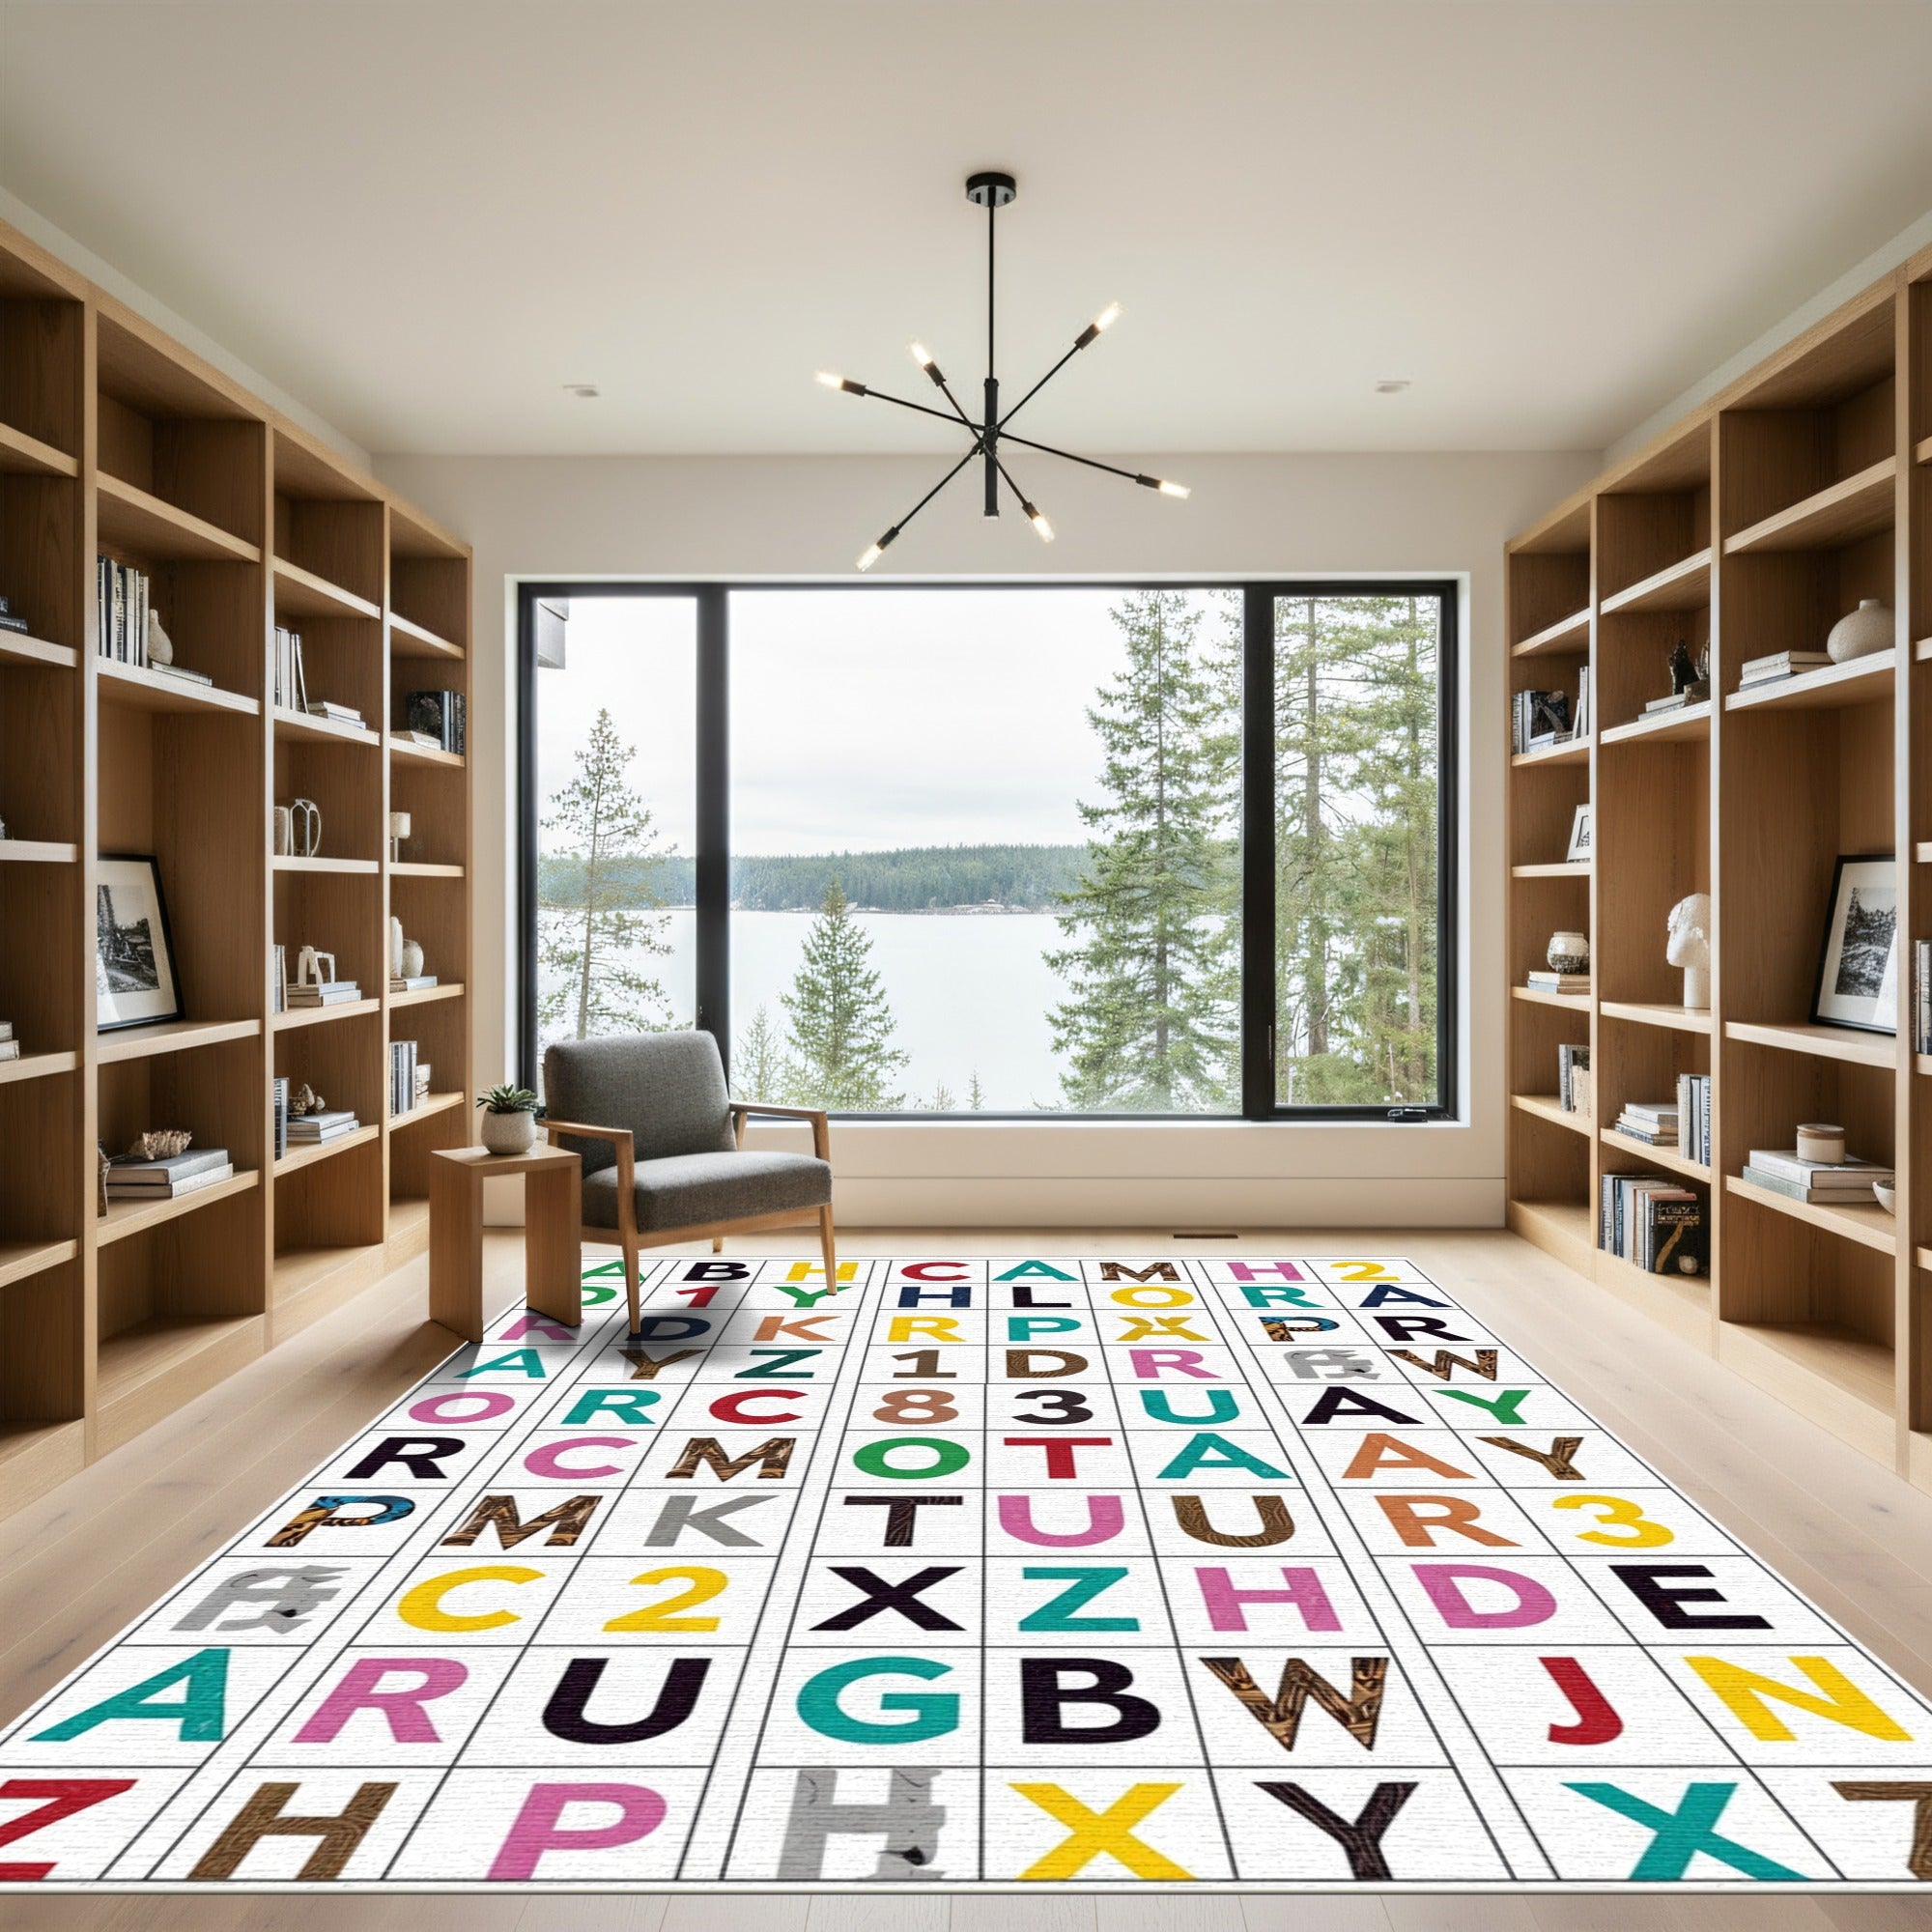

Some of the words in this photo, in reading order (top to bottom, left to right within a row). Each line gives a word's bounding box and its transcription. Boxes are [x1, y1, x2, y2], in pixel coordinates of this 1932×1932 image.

[582, 1261, 646, 1281] A
[682, 1263, 750, 1281] B
[785, 1263, 858, 1281] H
[901, 1262, 970, 1281] C
[994, 1261, 1077, 1281] A
[1100, 1263, 1180, 1282] M
[1228, 1263, 1303, 1280] H
[1331, 1262, 1400, 1281] 2
[677, 1287, 720, 1308] 1
[774, 1287, 851, 1308] Y
[898, 1287, 971, 1307] H
[1012, 1287, 1071, 1307] L
[1110, 1287, 1194, 1308] O
[1240, 1287, 1322, 1307] R
[1359, 1285, 1452, 1307] A
[626, 1317, 710, 1341] D
[753, 1317, 837, 1341] K
[888, 1317, 964, 1342] R
[1009, 1318, 1081, 1341] P
[1259, 1317, 1340, 1341] P
[1374, 1317, 1473, 1341] R
[453, 1349, 546, 1378] A
[617, 1350, 707, 1379] Y
[734, 1350, 822, 1378] Z
[893, 1350, 956, 1378] 1
[1007, 1350, 1088, 1378] D
[1130, 1350, 1222, 1378] R
[1384, 1350, 1497, 1381] W
[410, 1392, 514, 1424] O
[561, 1390, 661, 1424] R
[709, 1389, 808, 1424] C
[874, 1390, 957, 1424] 8
[1012, 1390, 1093, 1424] 3
[1140, 1390, 1239, 1425] U
[1302, 1387, 1424, 1424] A
[1434, 1390, 1530, 1424] Y
[343, 1437, 465, 1478] R
[525, 1437, 636, 1479] C
[666, 1437, 796, 1482] M
[854, 1437, 970, 1479] O
[1005, 1437, 1112, 1478] T
[1157, 1433, 1290, 1479] A
[1343, 1434, 1474, 1478] A
[1476, 1437, 1585, 1480] Y
[263, 1495, 415, 1547] P
[440, 1495, 603, 1550] M
[643, 1495, 780, 1547] K
[844, 1496, 962, 1547] T
[999, 1495, 1123, 1547] U
[1172, 1496, 1294, 1548] U
[1376, 1495, 1520, 1547] R
[1552, 1494, 1675, 1548] 3
[397, 1565, 546, 1633] C
[603, 1566, 729, 1633] 2
[809, 1567, 966, 1631] X
[1019, 1567, 1140, 1632] Z
[1196, 1567, 1343, 1631] H
[1411, 1565, 1557, 1629] D
[1608, 1565, 1774, 1629] E
[25, 1648, 231, 1742] A
[291, 1658, 468, 1743] R
[542, 1659, 712, 1745] U
[796, 1657, 959, 1745] G
[1021, 1659, 1160, 1744] B
[1199, 1658, 1389, 1751] W
[1539, 1658, 1623, 1746] J
[1684, 1656, 1914, 1742] N
[186, 1782, 399, 1880] H
[486, 1783, 667, 1880] P
[1007, 1783, 1199, 1880] X
[1254, 1782, 1419, 1880] Y
[1558, 1783, 1814, 1880] X
